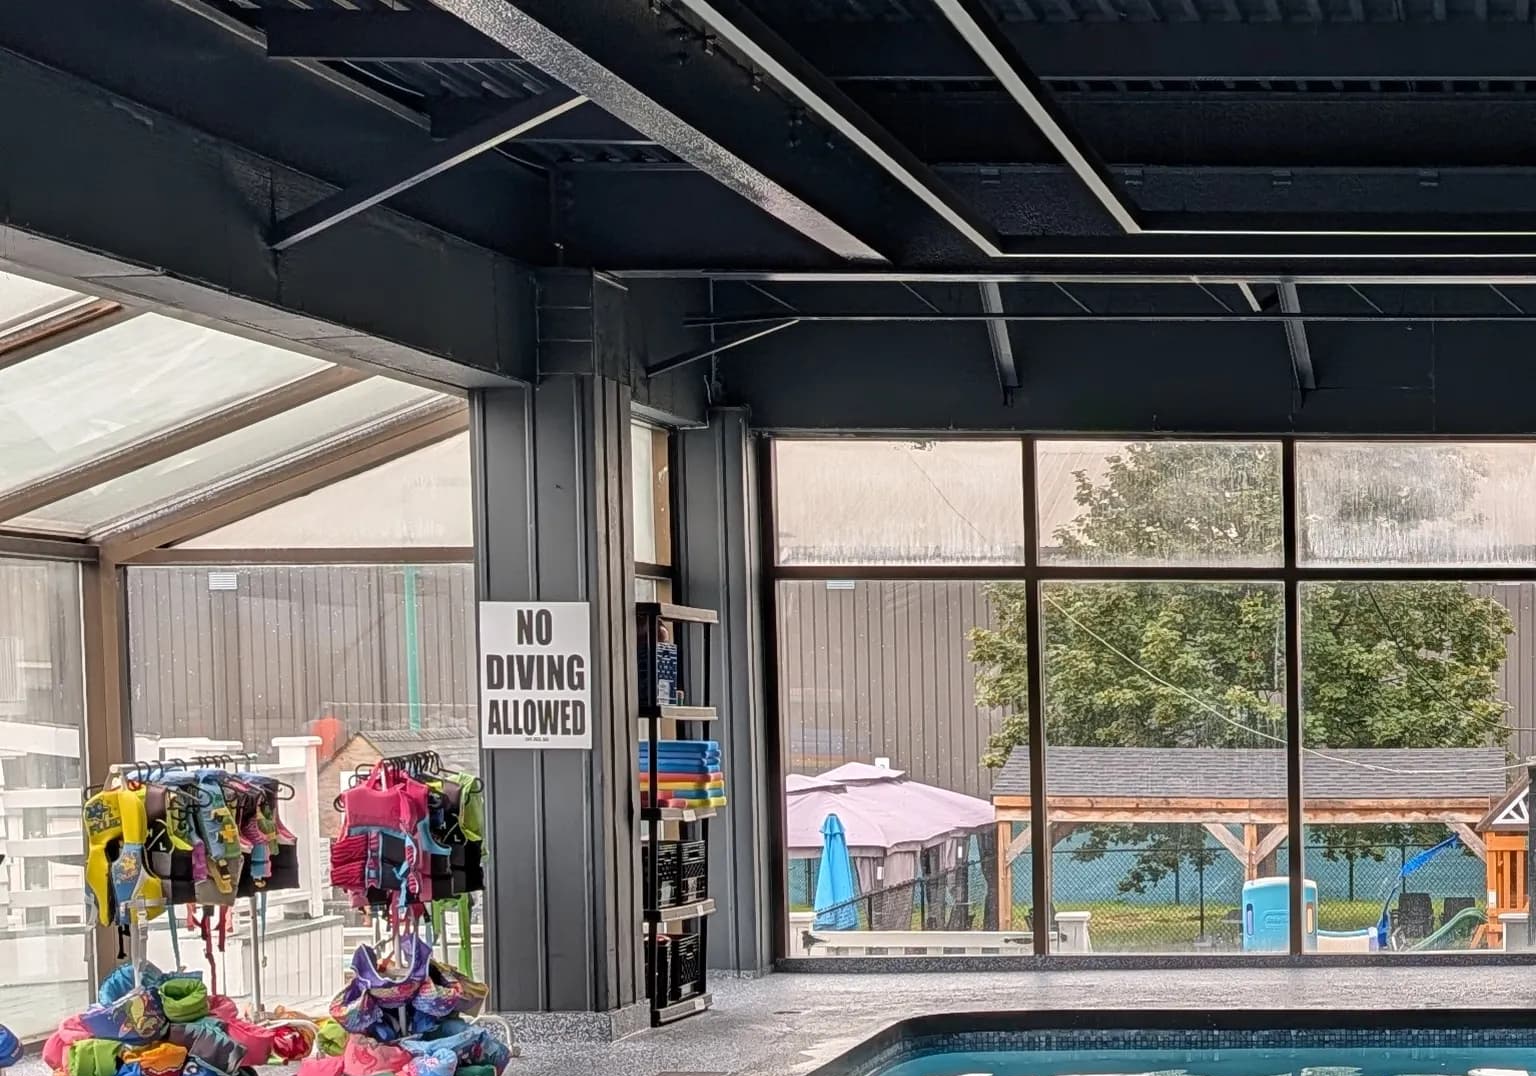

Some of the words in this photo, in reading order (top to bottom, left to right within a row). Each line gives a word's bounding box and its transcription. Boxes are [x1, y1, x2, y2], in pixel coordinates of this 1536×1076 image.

[516, 608, 553, 646] NO
[486, 653, 586, 692] DIVING
[487, 699, 586, 737] ALLOWED
